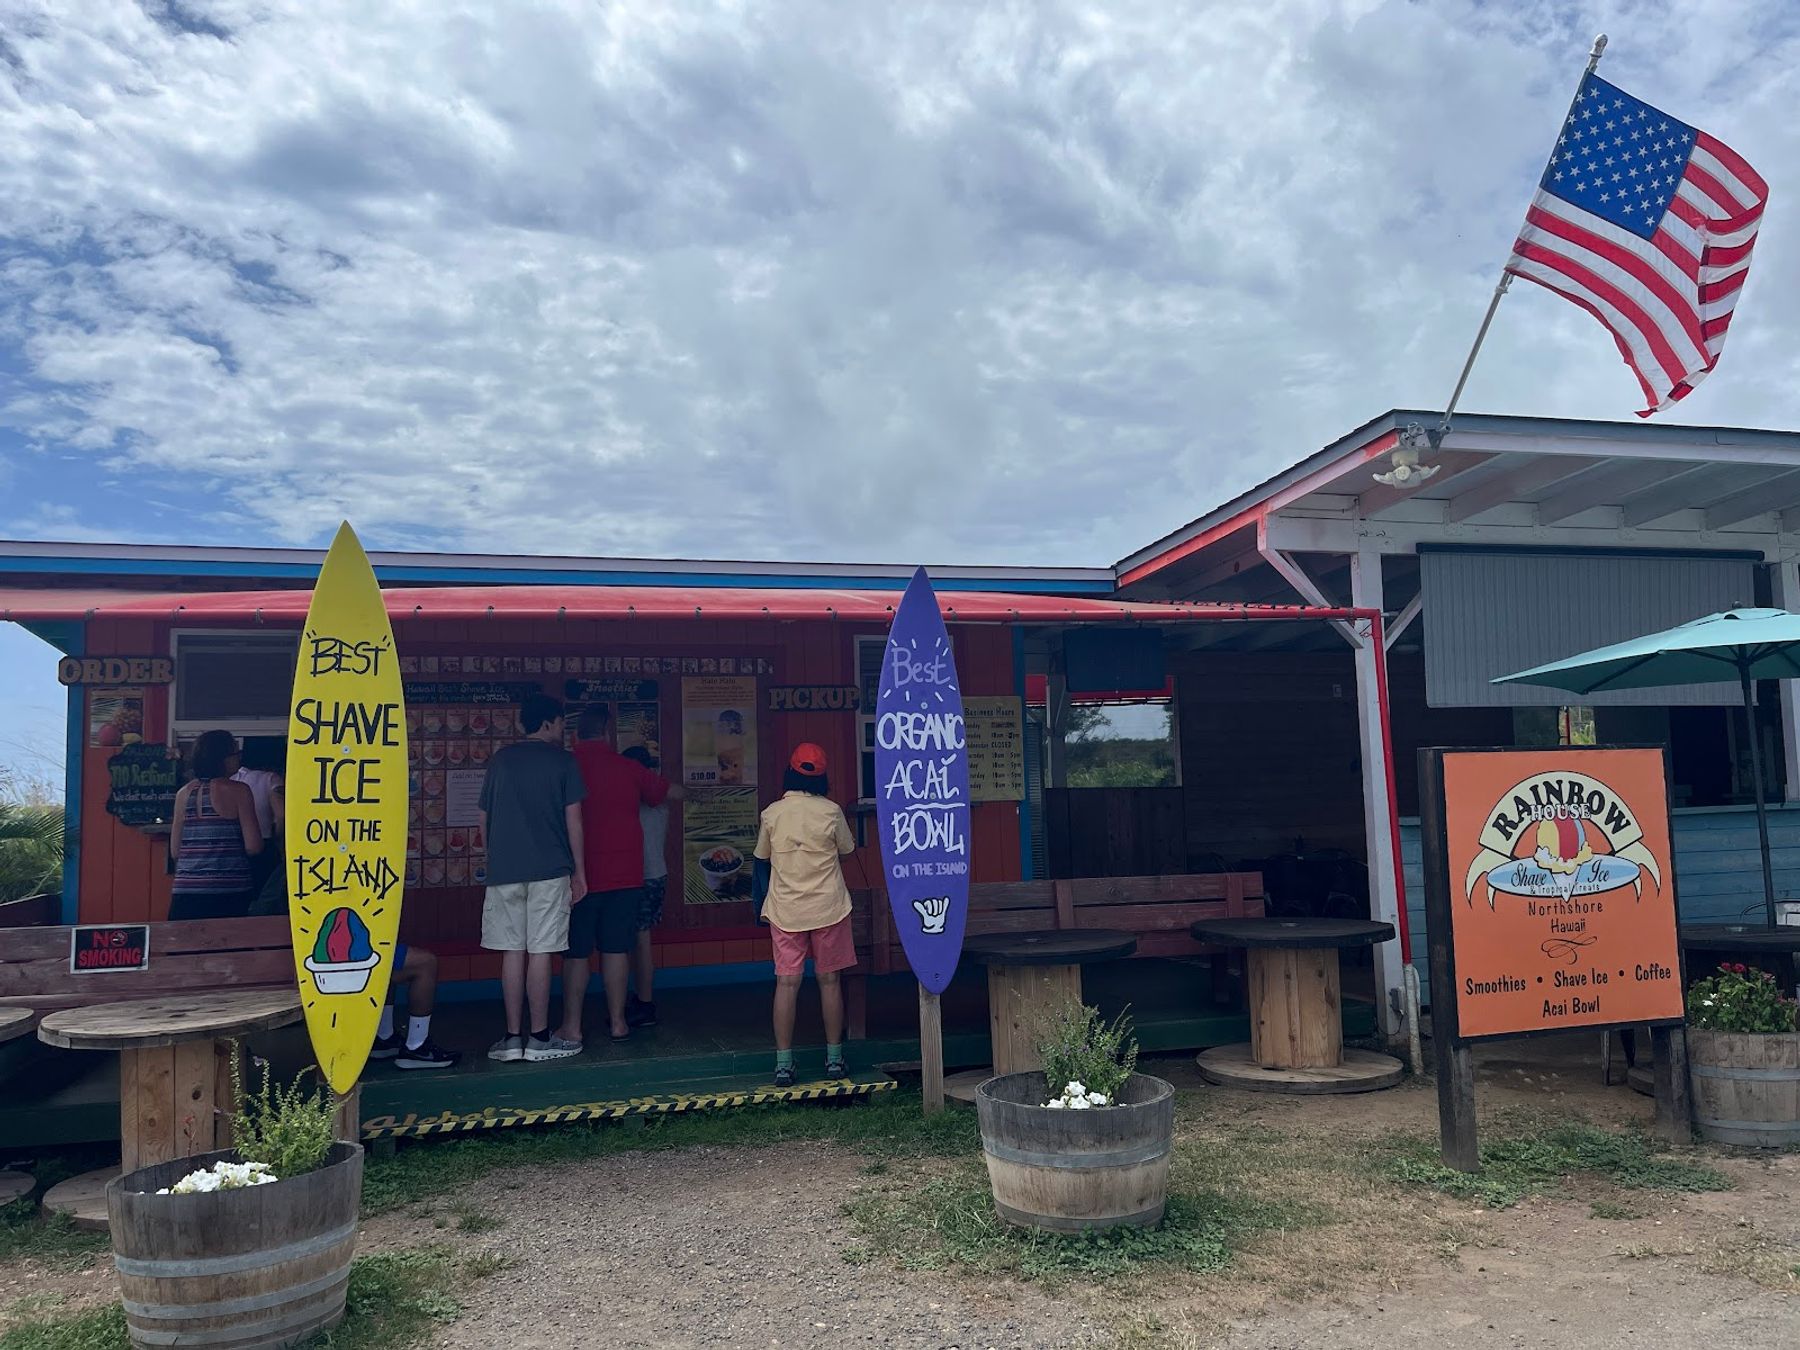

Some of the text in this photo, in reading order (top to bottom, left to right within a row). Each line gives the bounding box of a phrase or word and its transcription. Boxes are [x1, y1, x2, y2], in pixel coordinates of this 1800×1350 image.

[310, 637, 388, 677] BEST
[891, 647, 950, 688] Best
[59, 657, 174, 684] ORDER
[586, 683, 639, 693] Smoothies
[769, 687, 859, 709] PICKUP
[293, 698, 399, 747] SHAVE
[964, 707, 993, 717] Business
[991, 741, 1012, 749] CLOSED
[311, 757, 381, 804] ICE
[1492, 779, 1631, 841] RAINBOW
[1531, 803, 1591, 820] HOUSE
[306, 818, 382, 844] ON THE
[891, 811, 964, 855] BOWL
[293, 854, 399, 901] ISLAND
[893, 862, 968, 878] ON THE ISLAND
[1510, 858, 1610, 888] Shave Ice
[1528, 898, 1603, 916] Northshore
[1551, 918, 1586, 933] Hawaii
[93, 929, 128, 948] NO
[79, 947, 142, 968] SMOKING
[1465, 963, 1672, 996] Smoothies Shave Ice Coffee
[1542, 995, 1600, 1018] Acai Bowl
